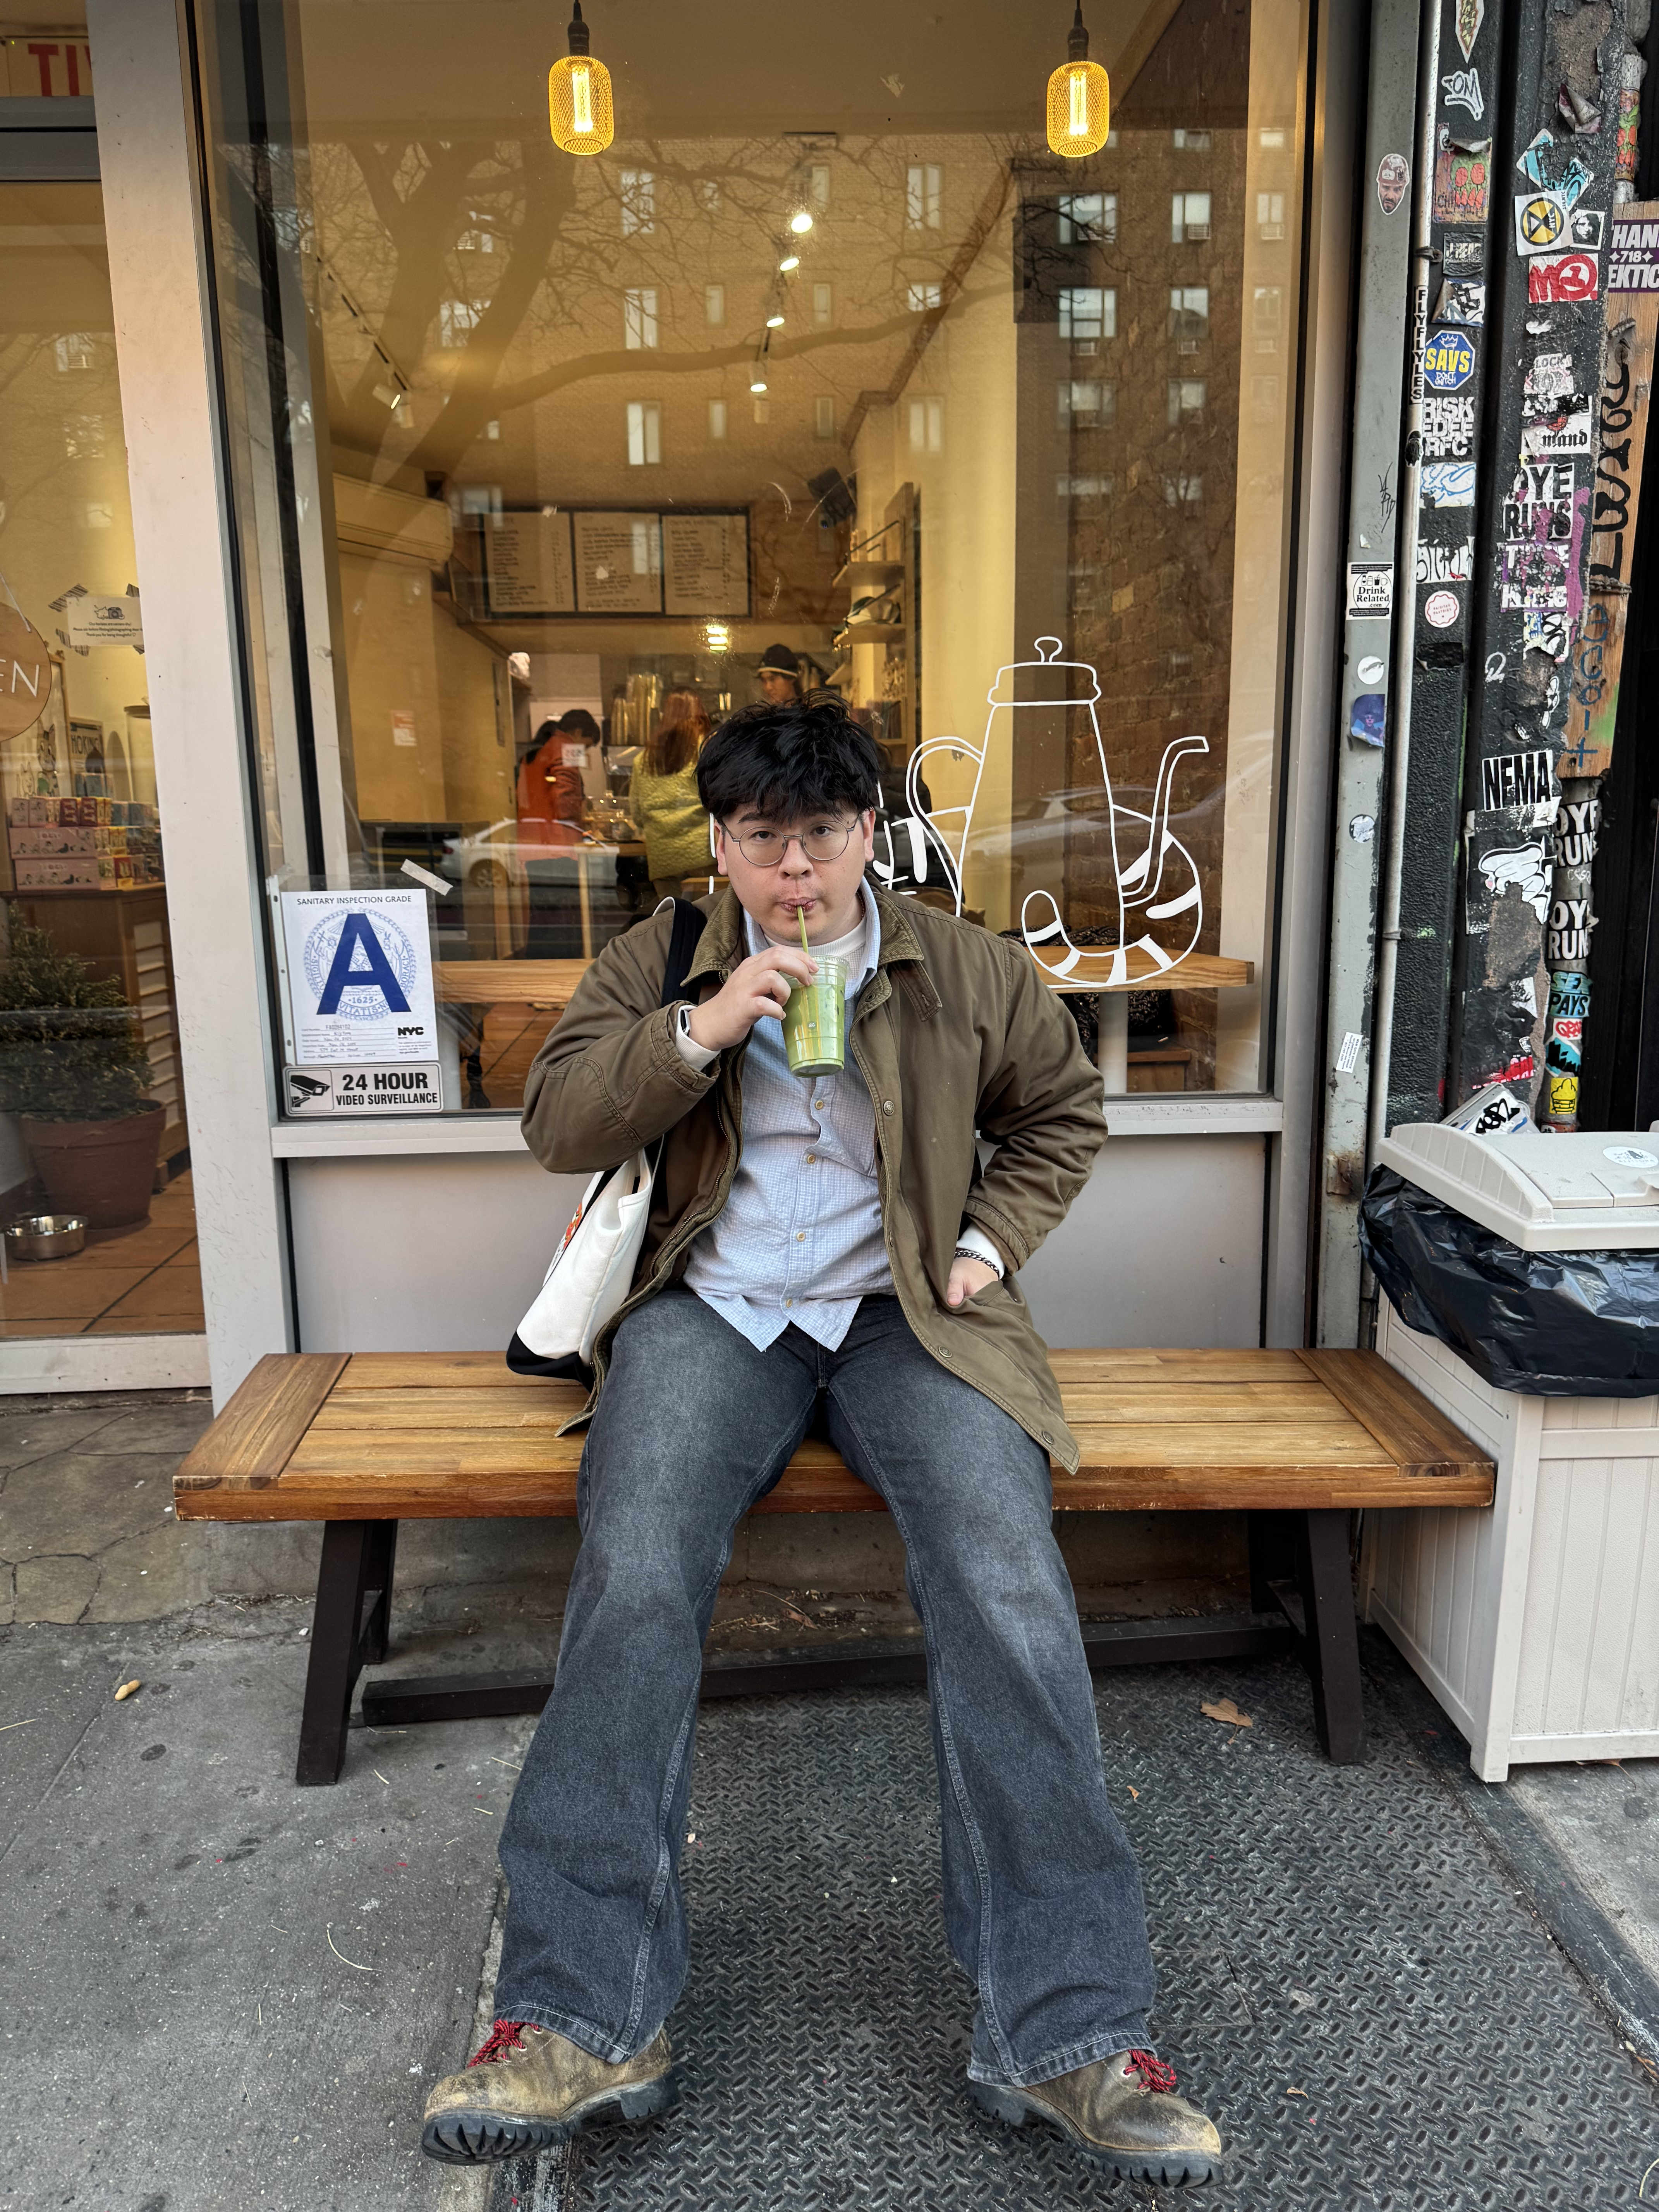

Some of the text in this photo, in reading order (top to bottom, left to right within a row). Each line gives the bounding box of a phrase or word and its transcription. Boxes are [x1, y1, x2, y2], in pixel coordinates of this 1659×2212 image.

[28, 44, 92, 96] TI
[1611, 225, 1659, 248] HAN
[1620, 251, 1642, 263] 718
[1425, 348, 1470, 373] SAVS
[1423, 397, 1475, 422] RISK
[1425, 436, 1468, 456] RFC
[1357, 594, 1389, 602] Related
[1358, 586, 1386, 594] Drink
[337, 896, 383, 904] INSPECTION
[1549, 899, 1590, 930] OY
[316, 913, 412, 1015] A
[1550, 971, 1593, 995] SEX
[1550, 993, 1589, 1016] PAYS
[397, 1027, 424, 1036] NYC
[342, 1072, 429, 1091] 24 HOUR
[335, 1092, 438, 1106] VIDEO SURVEILLANCE
